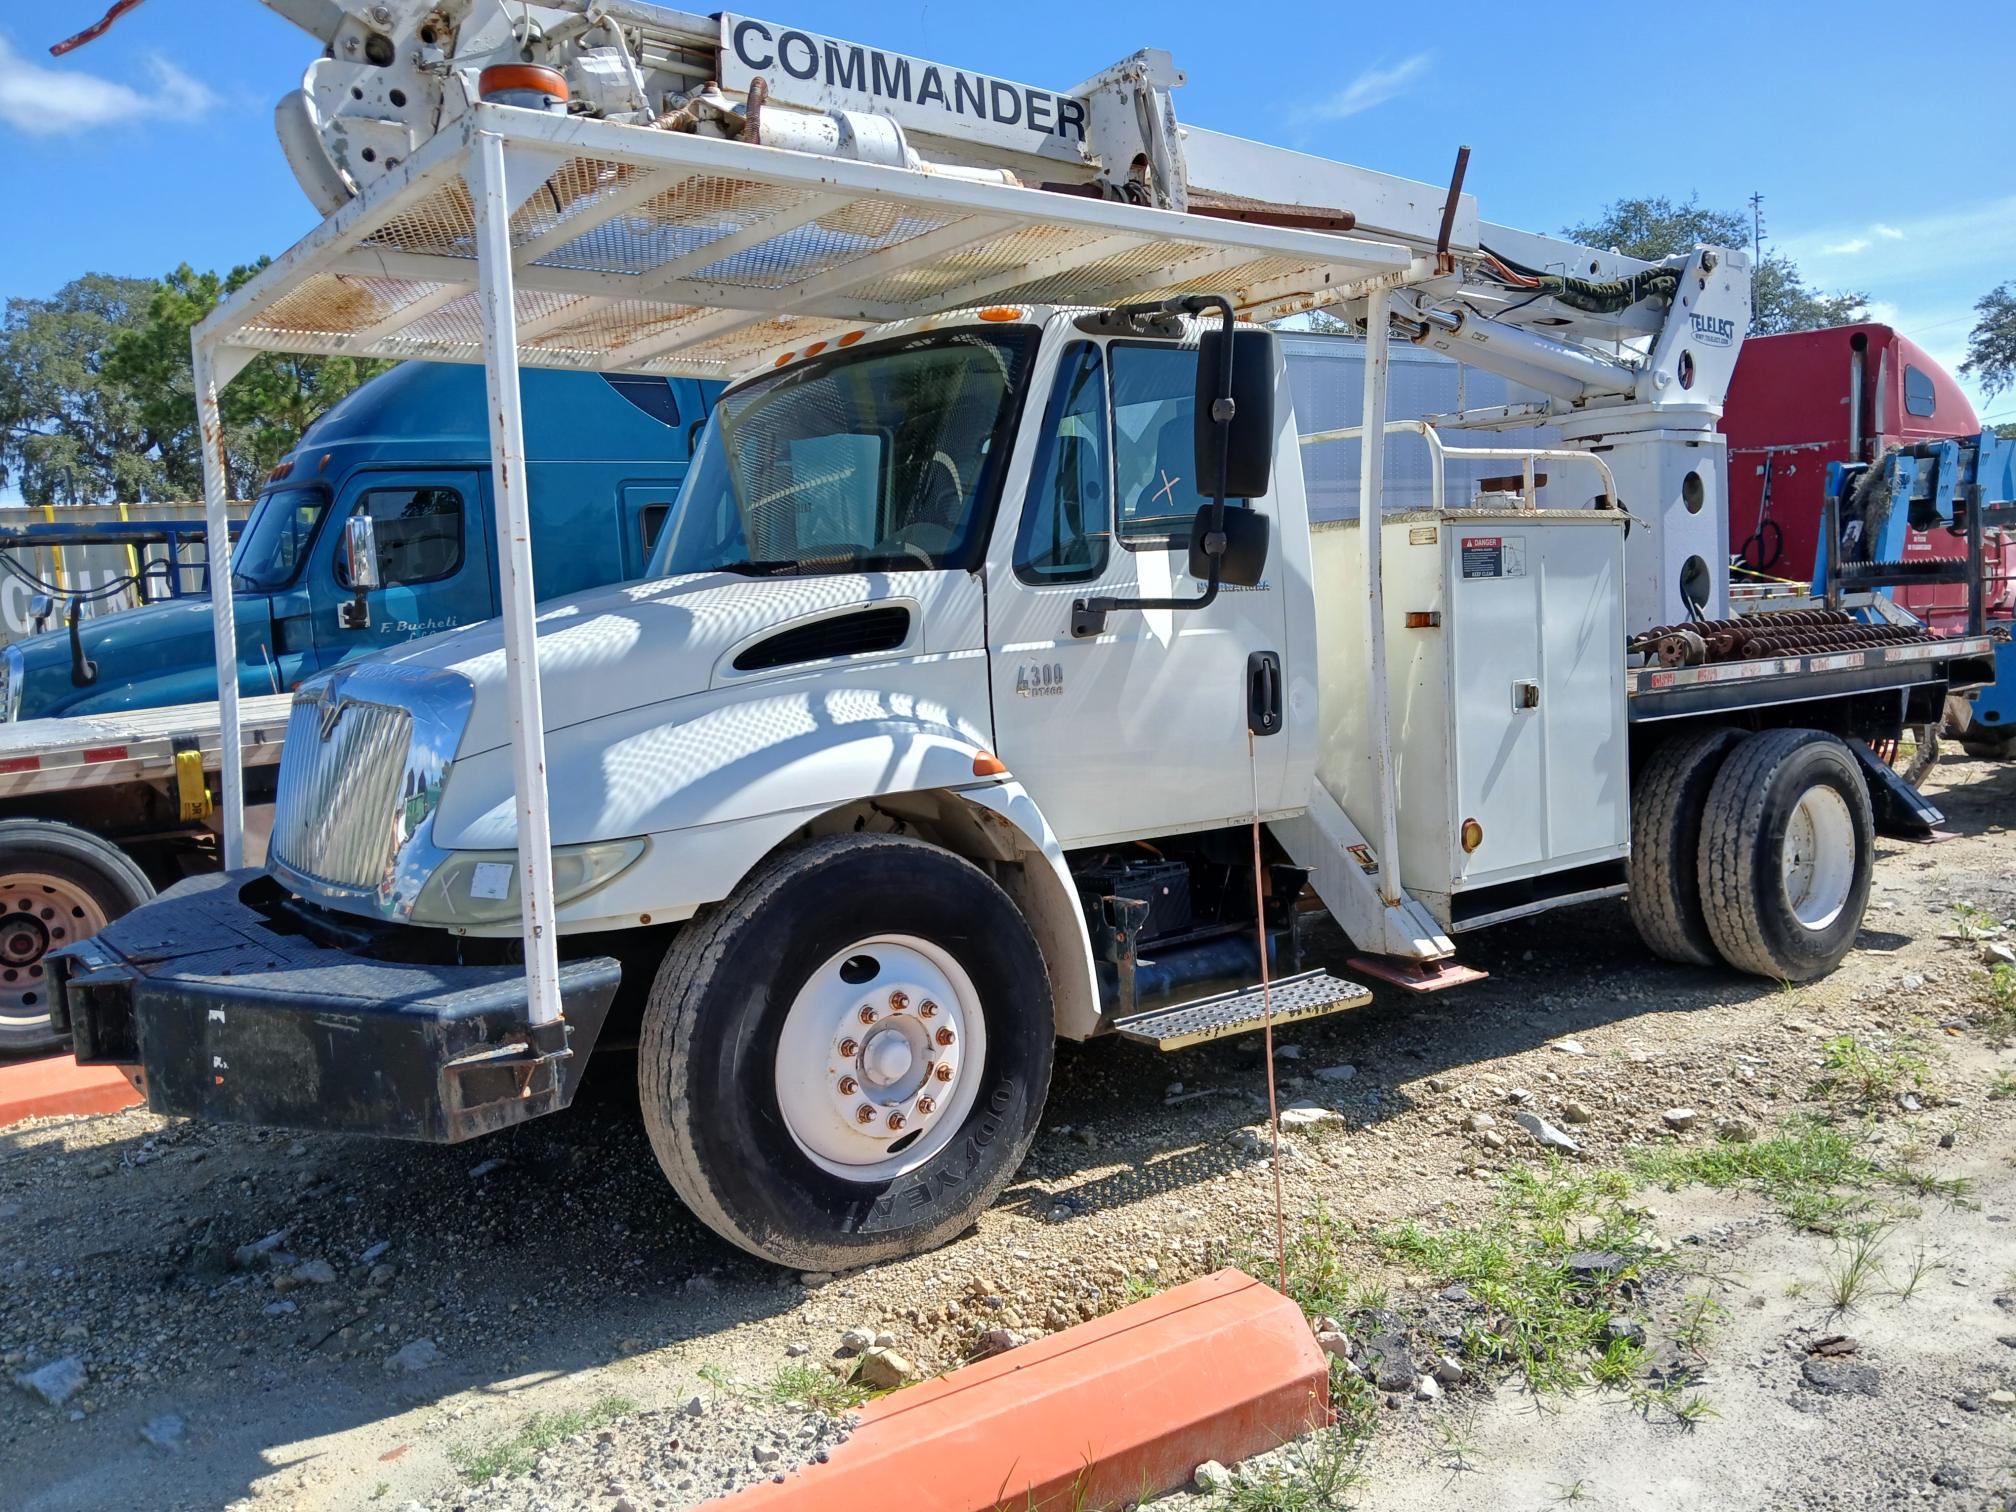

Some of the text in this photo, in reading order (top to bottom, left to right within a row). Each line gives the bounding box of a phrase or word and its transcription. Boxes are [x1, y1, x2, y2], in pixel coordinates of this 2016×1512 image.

[733, 20, 1086, 142] COMMANDER
[1689, 312, 1735, 341] TELELECT
[1016, 663, 1063, 697] 4300
